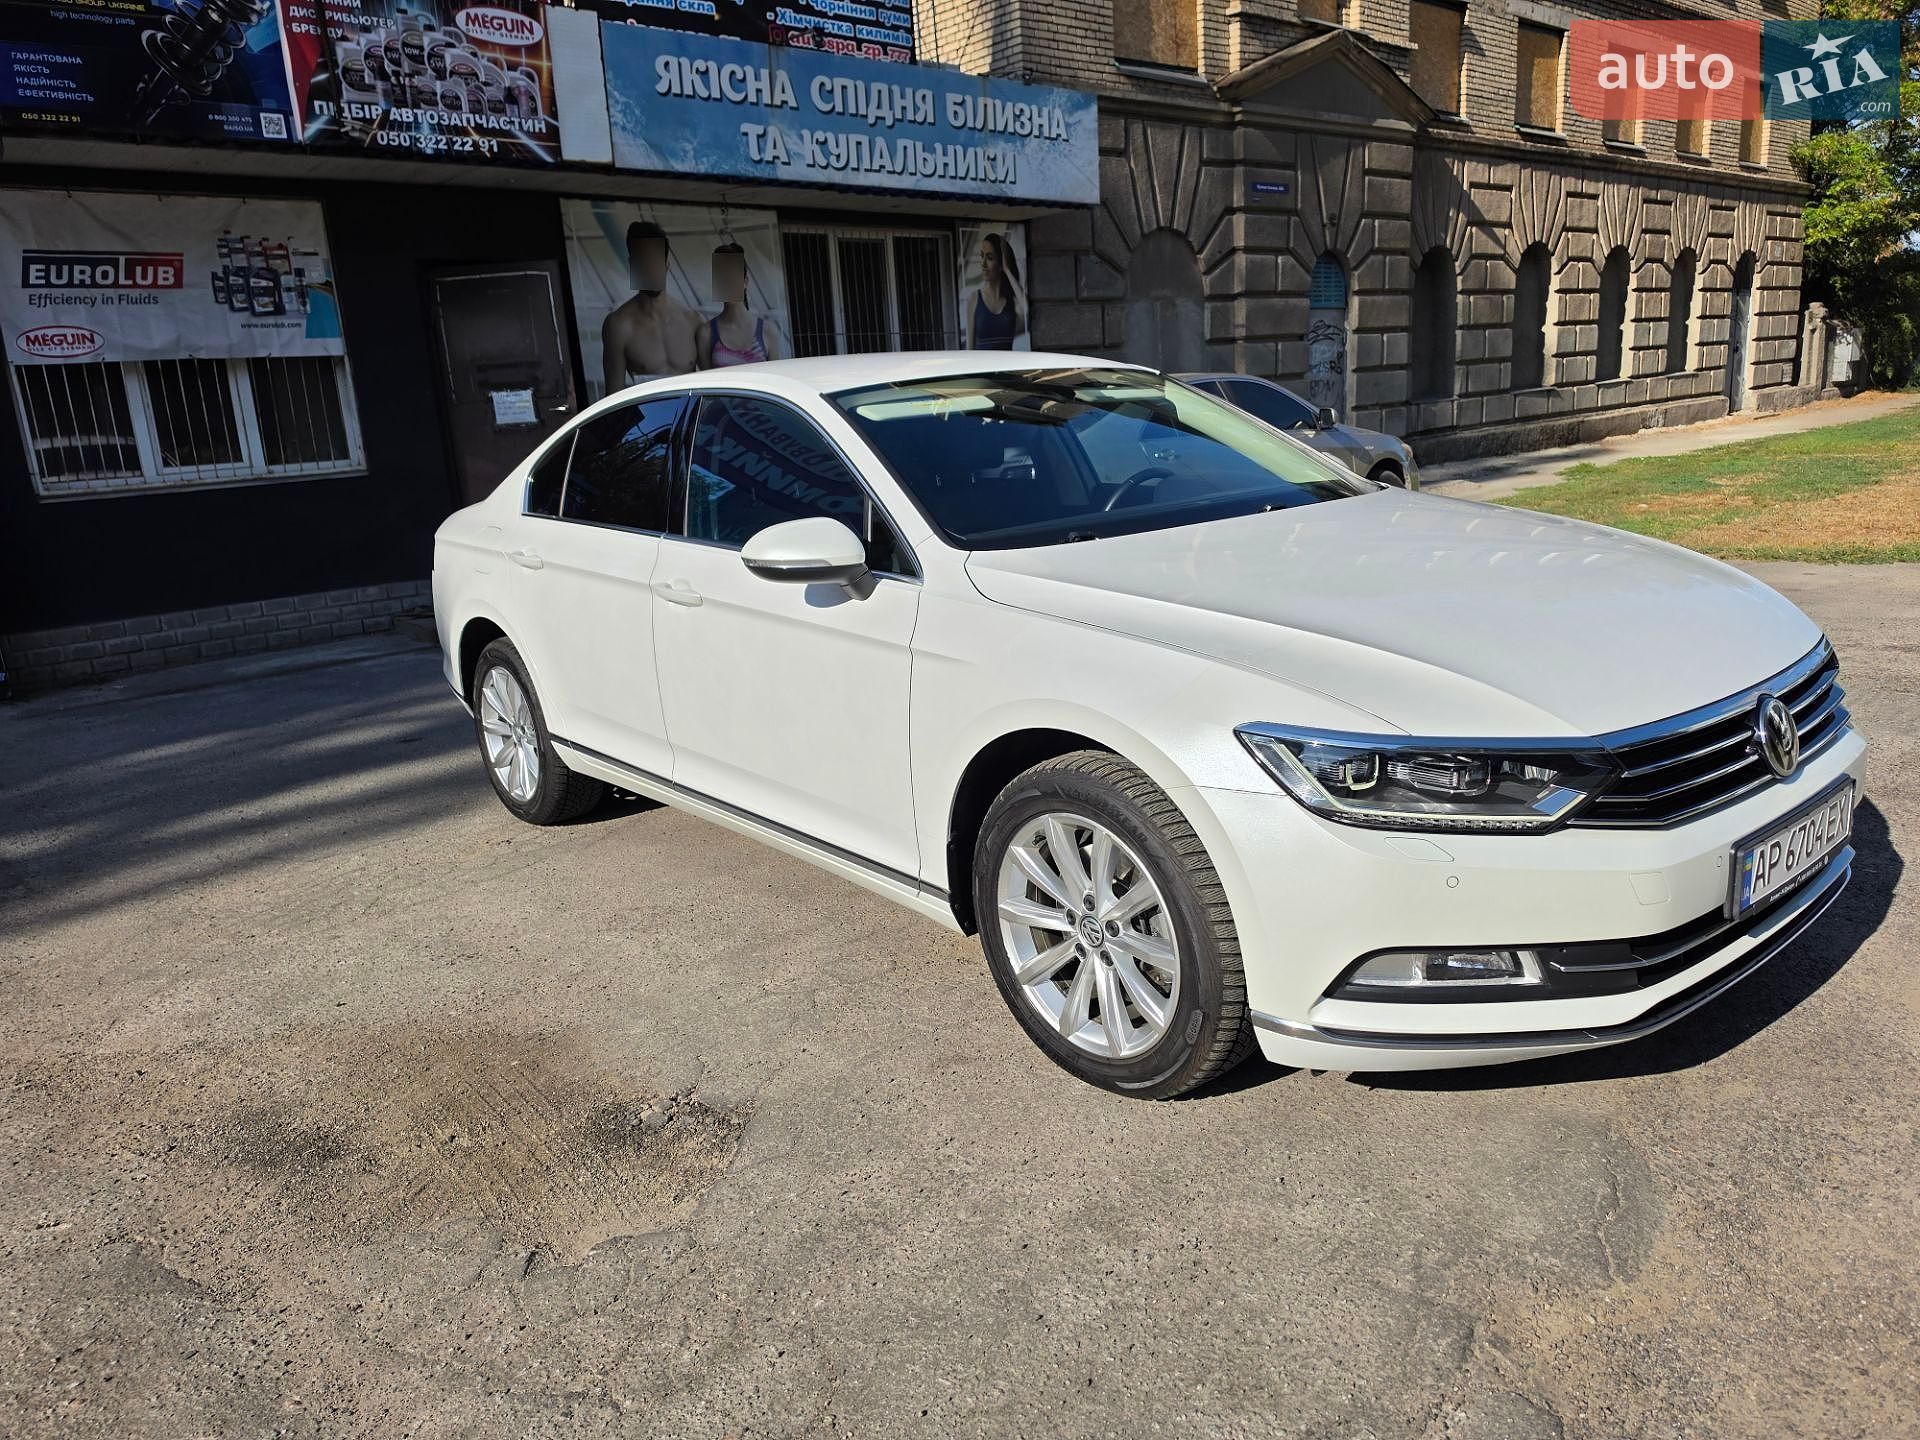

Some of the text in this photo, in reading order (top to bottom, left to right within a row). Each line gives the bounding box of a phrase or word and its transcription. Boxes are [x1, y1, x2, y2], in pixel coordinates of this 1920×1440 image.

[50, 10, 136, 26] high technology parts
[289, 5, 394, 28] ДИСРИБЬЮТЕР
[878, 9, 911, 27] гуми
[777, 7, 855, 37] Хімчистка
[856, 24, 914, 47] килимів
[11, 52, 83, 65] ГАРАНТОВАНА
[13, 64, 50, 74] ЯКІСТЬ
[16, 76, 77, 89] НАДІЙНІСТЬ
[18, 88, 95, 102] ЕФЕКТИВНІСТЬ
[655, 54, 1069, 141] ЯКІСНА СПІДНЯ БІЛИЗНА
[21, 112, 39, 120] 050
[389, 107, 547, 133] АВТОЗАПЧАСТИН
[377, 130, 499, 153] 050 322 22 91
[740, 122, 1017, 184] ТА КУПАЛЬНИКИ
[29, 256, 175, 286] EUROLUB
[28, 293, 159, 308] Efficiency in Fluids
[1751, 839, 1781, 894] AP
[1785, 811, 1825, 872] 6704
[1824, 794, 1847, 845] EX
